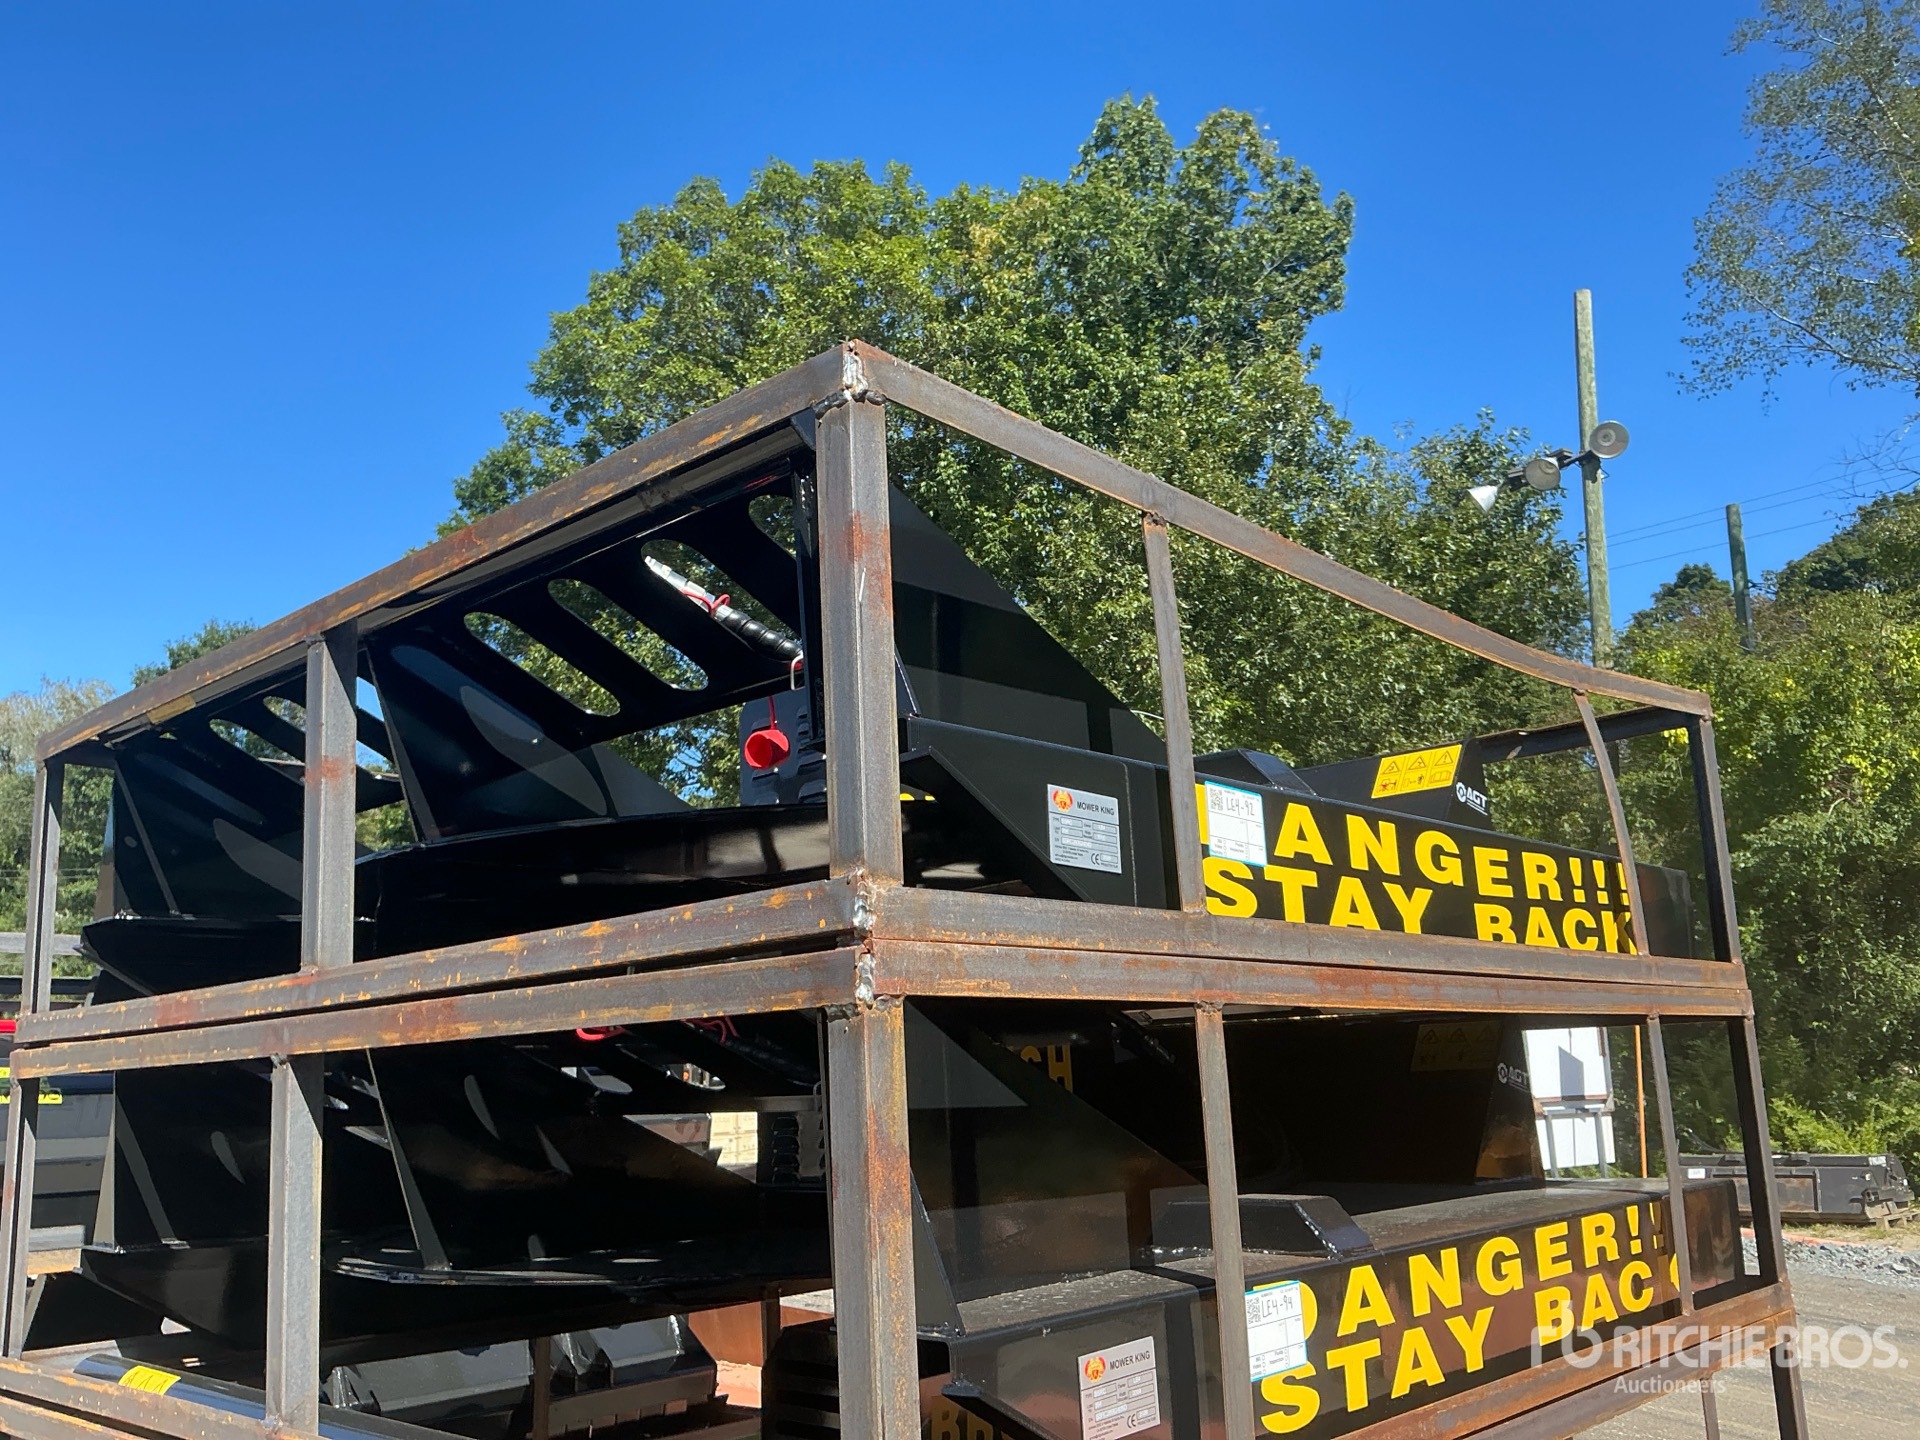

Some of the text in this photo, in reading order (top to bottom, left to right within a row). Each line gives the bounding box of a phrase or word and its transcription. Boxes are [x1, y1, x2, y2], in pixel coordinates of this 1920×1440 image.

[1076, 801, 1115, 816] MOWER KING
[1466, 786, 1488, 808] AGT
[1195, 783, 1630, 906] ANGER!!!
[1203, 856, 1638, 956] STAY BACK
[1109, 1350, 1151, 1370] MOWER KING
[1260, 1306, 1495, 1435] STAY
